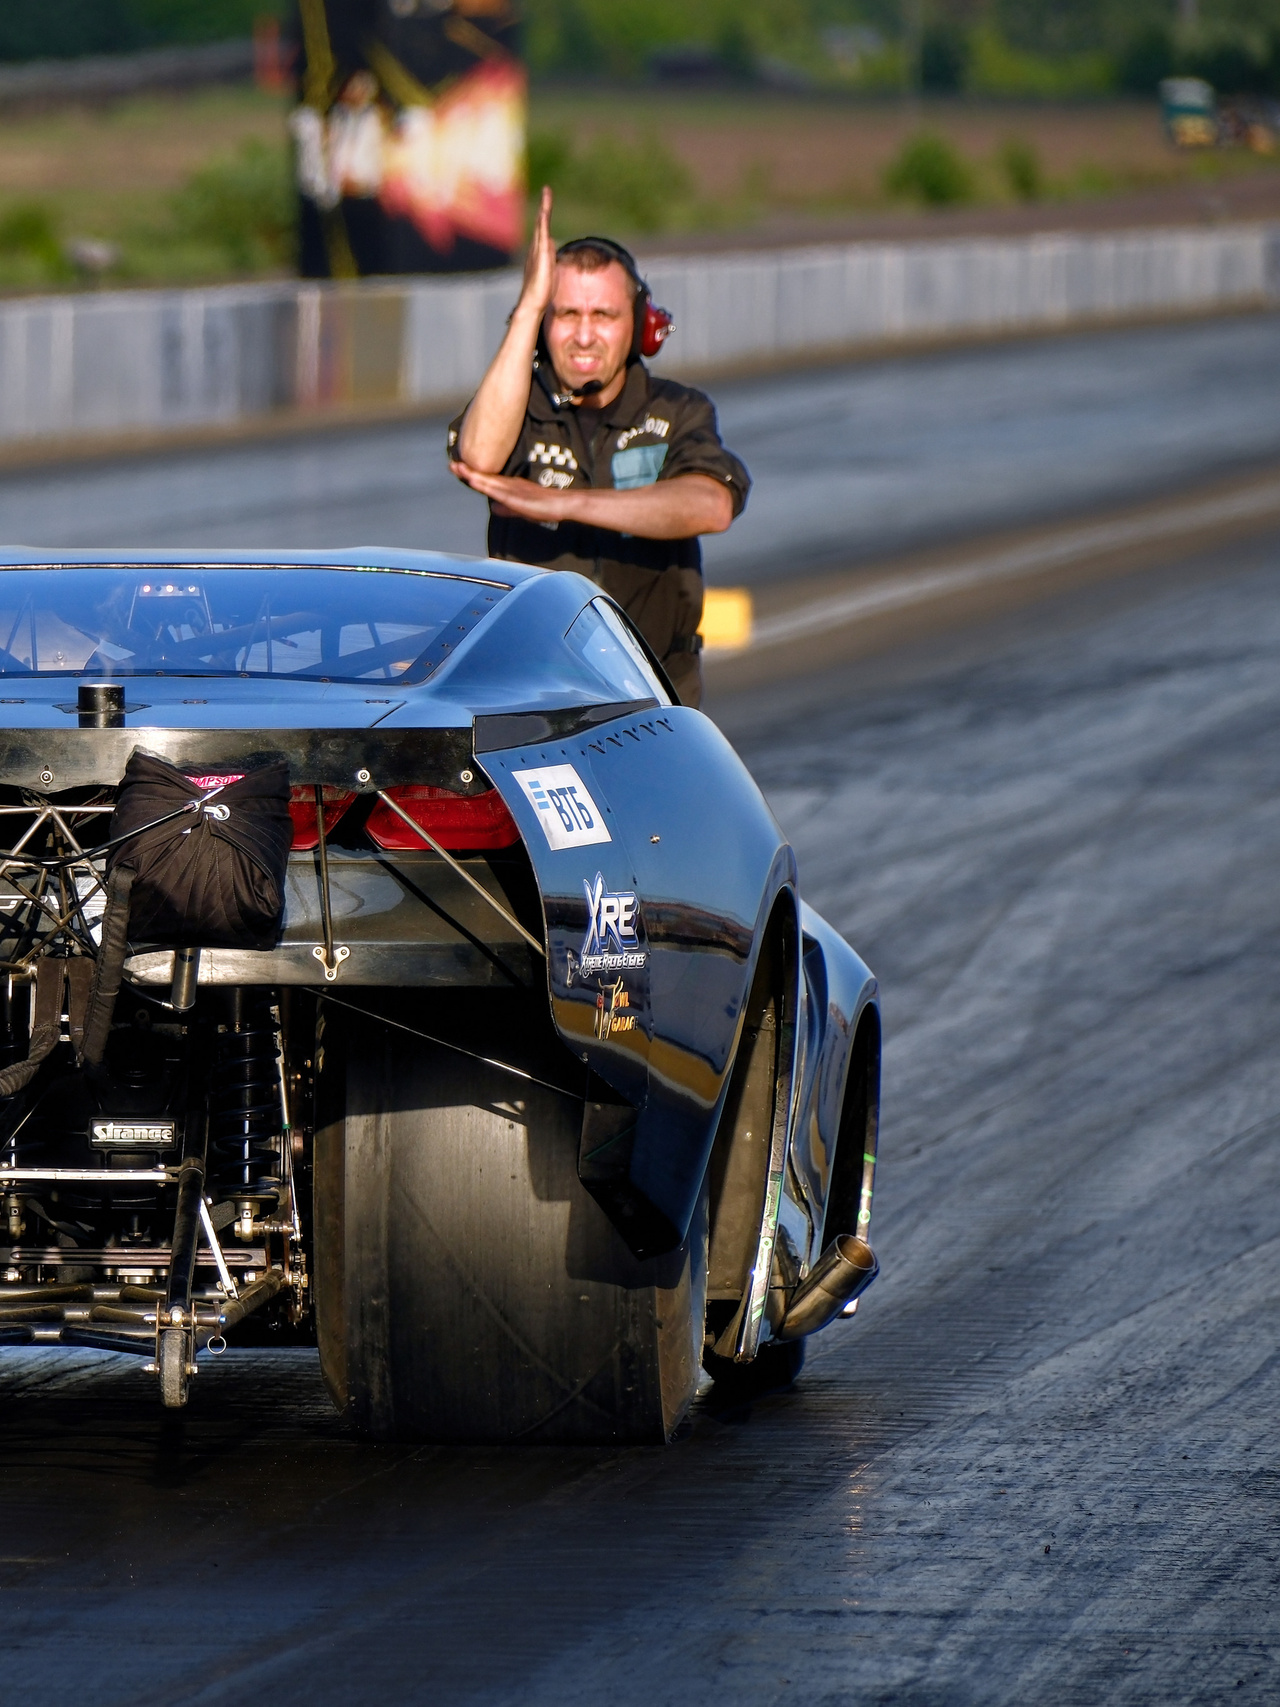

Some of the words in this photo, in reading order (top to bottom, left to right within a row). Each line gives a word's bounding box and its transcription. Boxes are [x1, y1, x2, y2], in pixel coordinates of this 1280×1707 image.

[547, 786, 594, 832] ВТБ
[581, 873, 638, 954] XRE
[93, 1122, 173, 1142] Strange
